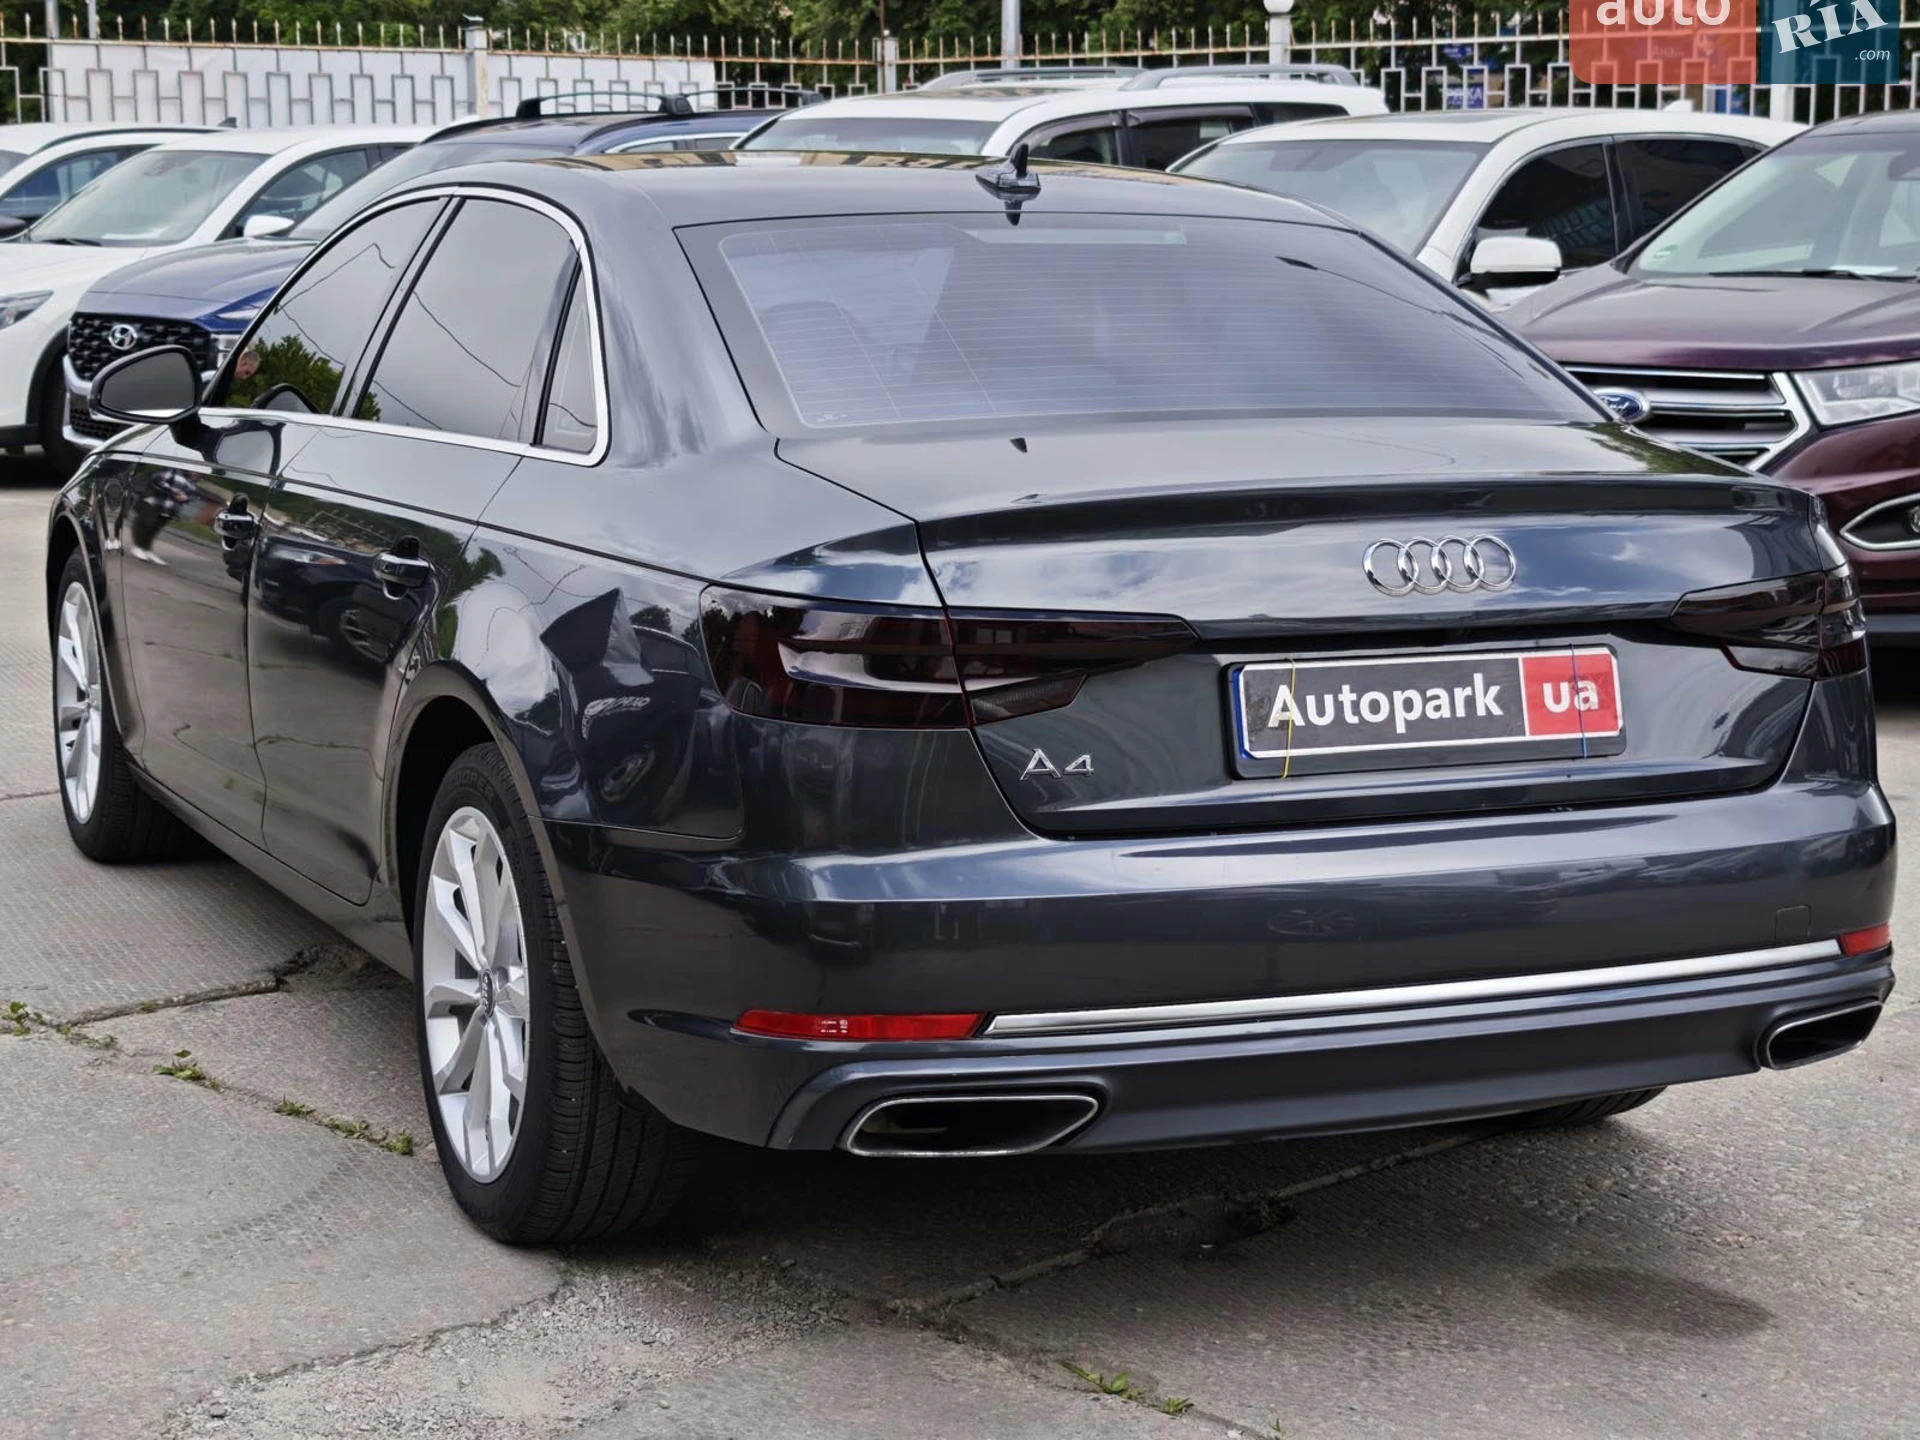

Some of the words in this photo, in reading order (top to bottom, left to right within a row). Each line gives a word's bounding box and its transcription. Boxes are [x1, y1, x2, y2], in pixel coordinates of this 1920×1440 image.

[1267, 672, 1505, 734] Autopark
[1542, 678, 1601, 714] ua
[1019, 748, 1095, 781] A4
